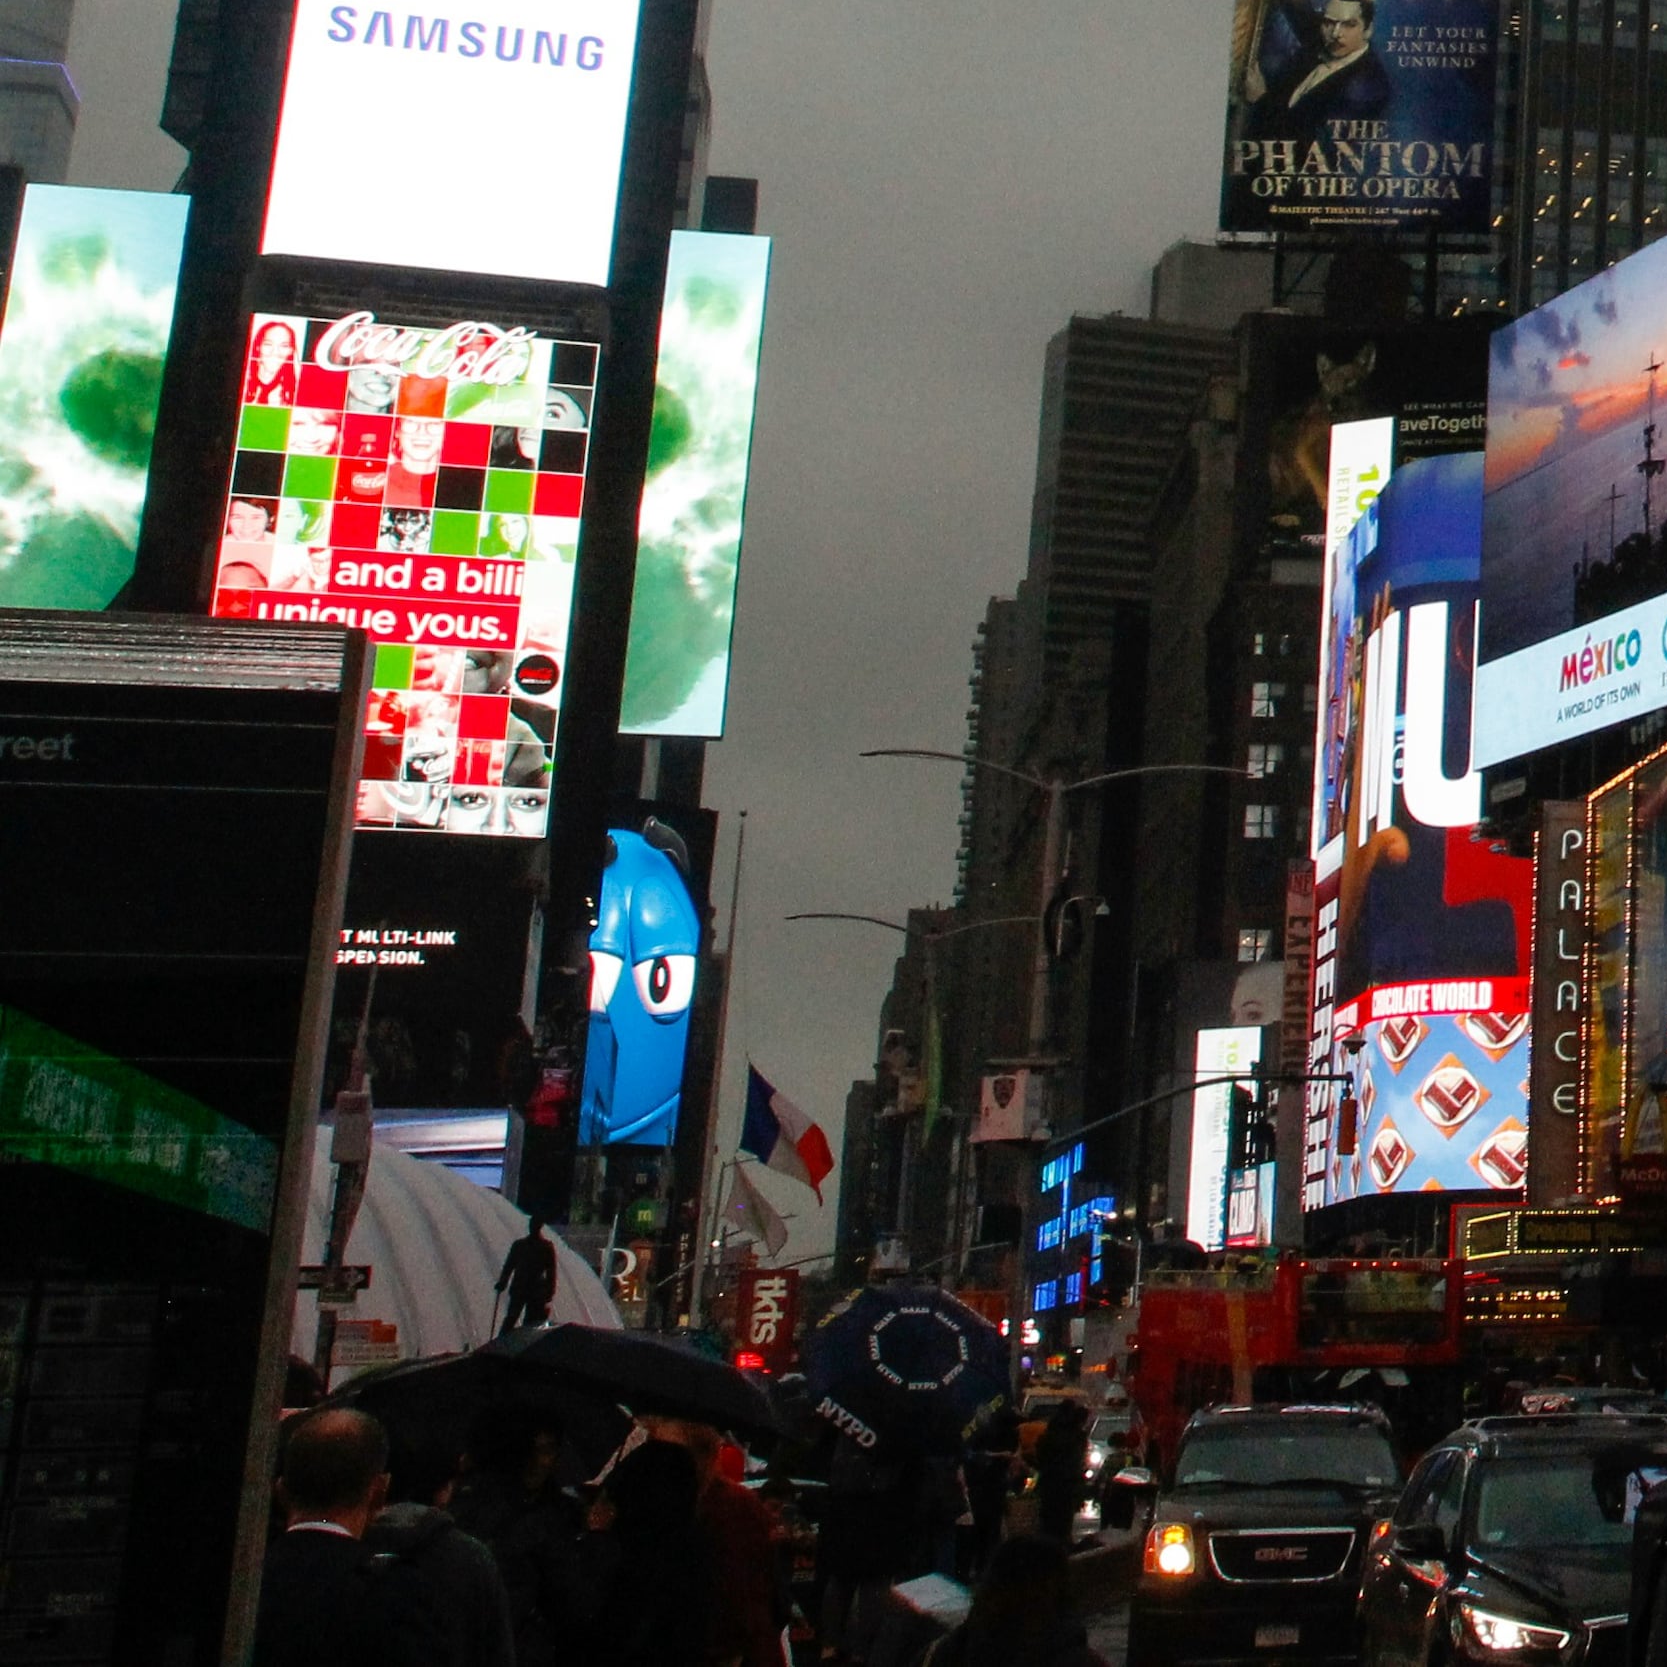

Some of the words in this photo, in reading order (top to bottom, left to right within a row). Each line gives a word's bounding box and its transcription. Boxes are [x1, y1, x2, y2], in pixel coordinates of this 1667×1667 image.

[326, 5, 606, 71] SAMSUNG
[1386, 40, 1489, 54] FANTASIES
[1392, 26, 1427, 39] LET
[1435, 27, 1486, 39] YOUR
[1398, 56, 1476, 69] UNWIND
[1327, 119, 1388, 140] THE
[1231, 140, 1485, 178] PHANTOM
[1252, 176, 1291, 198] OF
[1298, 177, 1357, 198] THE
[1362, 178, 1461, 200] OPERA
[1325, 206, 1366, 215] THEATRE
[315, 311, 537, 385] Coca-Cola
[334, 559, 416, 590] and
[420, 567, 452, 592] a
[406, 610, 508, 643] yous.
[1556, 709, 1563, 723] A
[1563, 697, 1593, 718] WORLD
[1594, 693, 1608, 710] OF
[1606, 689, 1620, 705] ITS
[1620, 682, 1641, 703] OWN
[1552, 828, 1584, 1115] PALACE
[1371, 984, 1430, 1019] CHOCOLATE
[1431, 981, 1493, 1012] WORLD
[751, 1275, 788, 1346] tkts
[816, 1396, 878, 1449] NYPD
[1254, 1547, 1308, 1562] GMC
